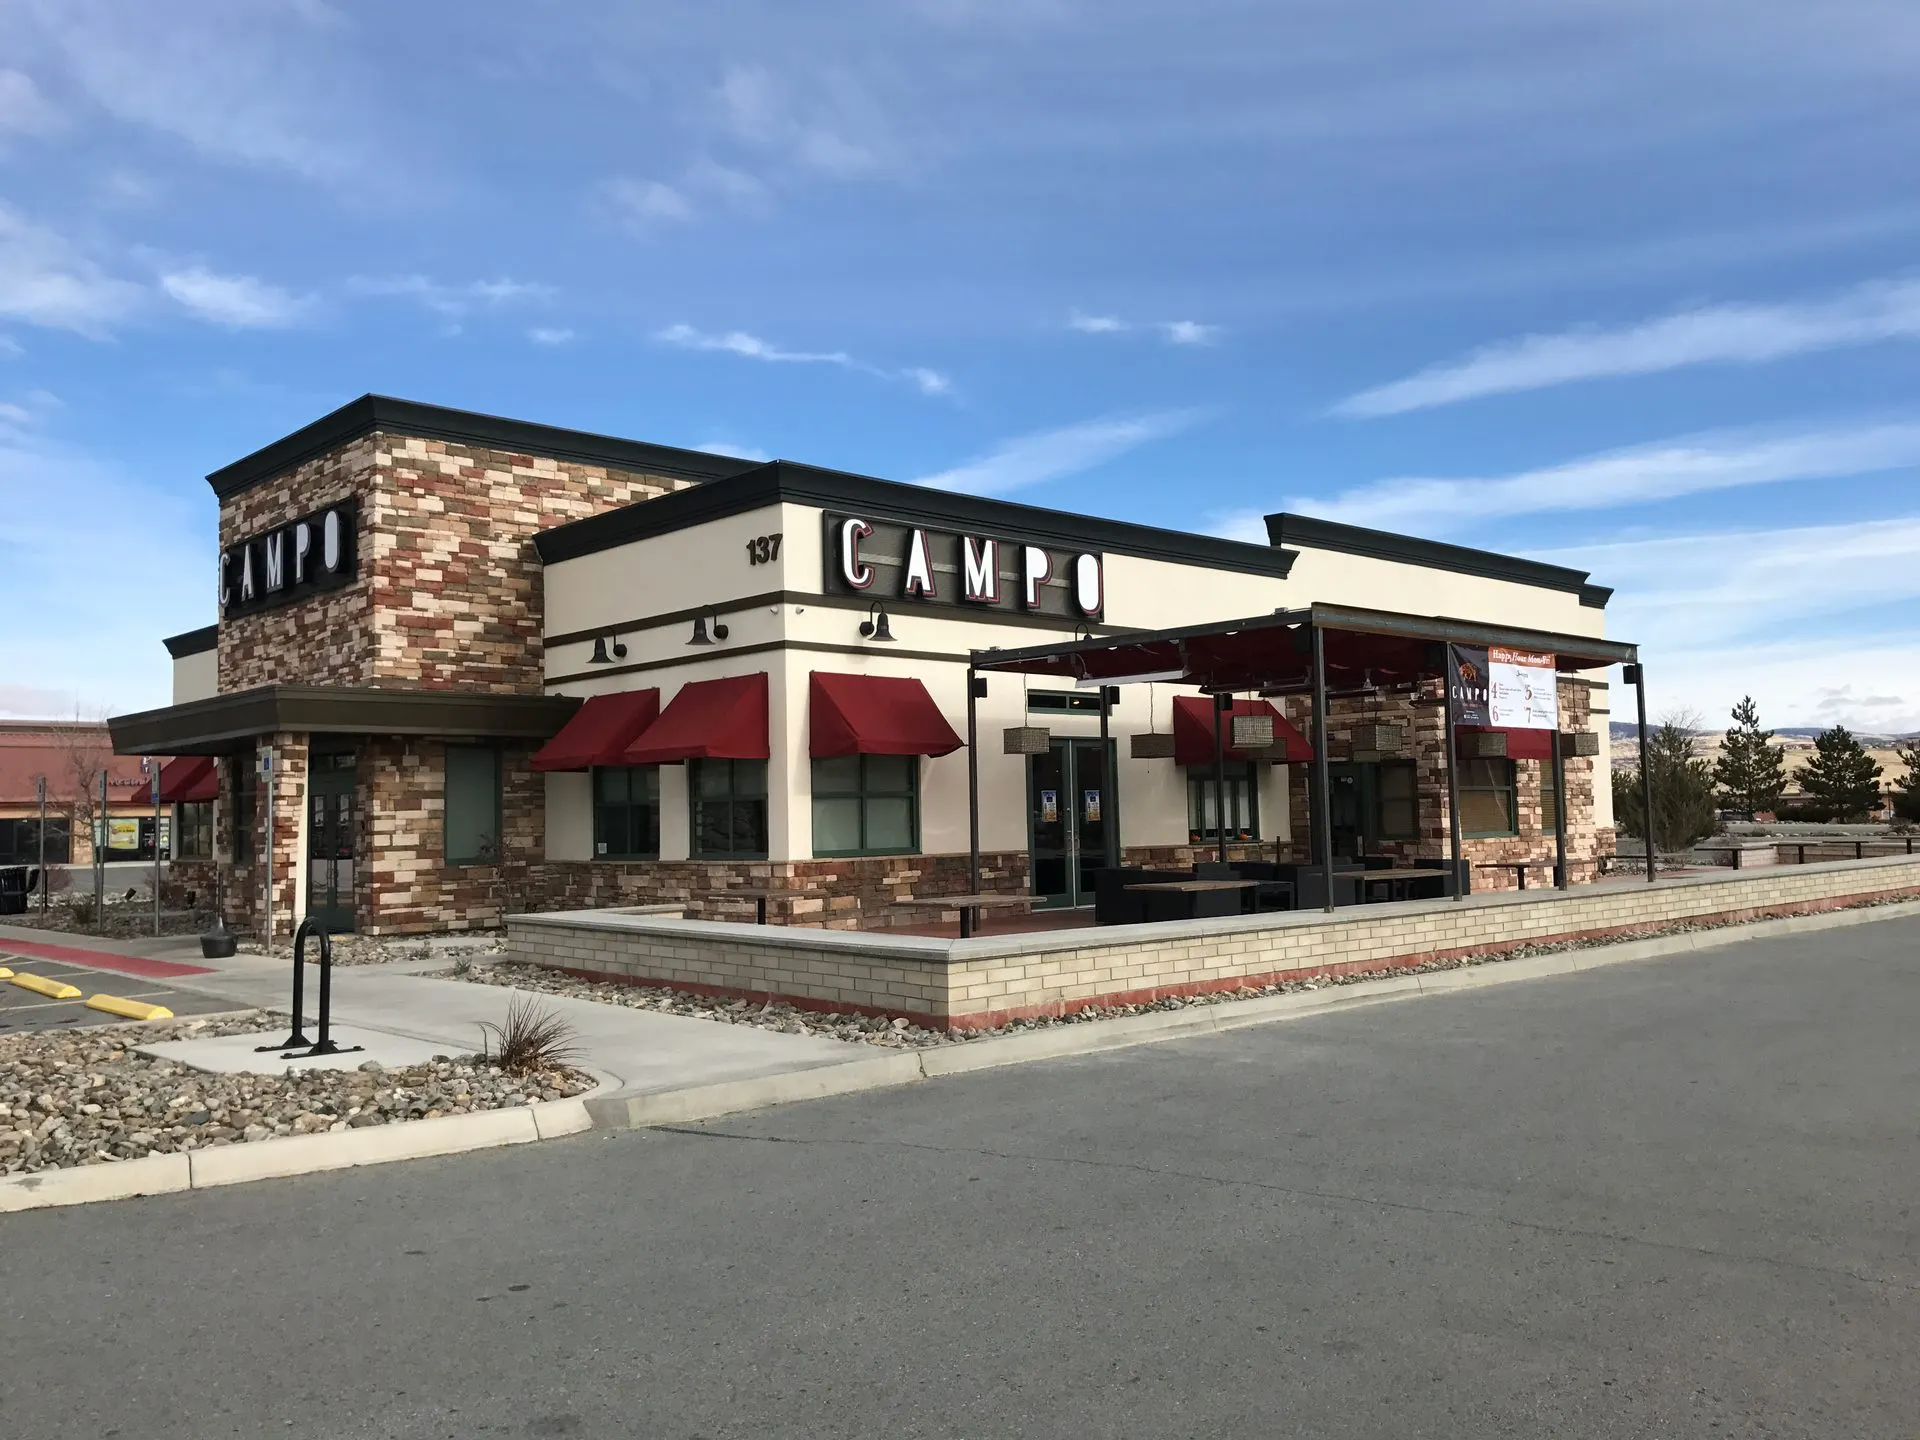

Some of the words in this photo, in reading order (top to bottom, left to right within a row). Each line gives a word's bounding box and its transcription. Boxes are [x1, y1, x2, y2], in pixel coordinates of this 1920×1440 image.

[219, 510, 341, 608] CAMPO
[746, 533, 783, 565] 137
[840, 518, 1103, 615] CAMPO
[1492, 649, 1511, 663] Happy
[1512, 652, 1527, 663] Hour
[1452, 685, 1488, 702] CAMPO
[1490, 681, 1498, 699] 4
